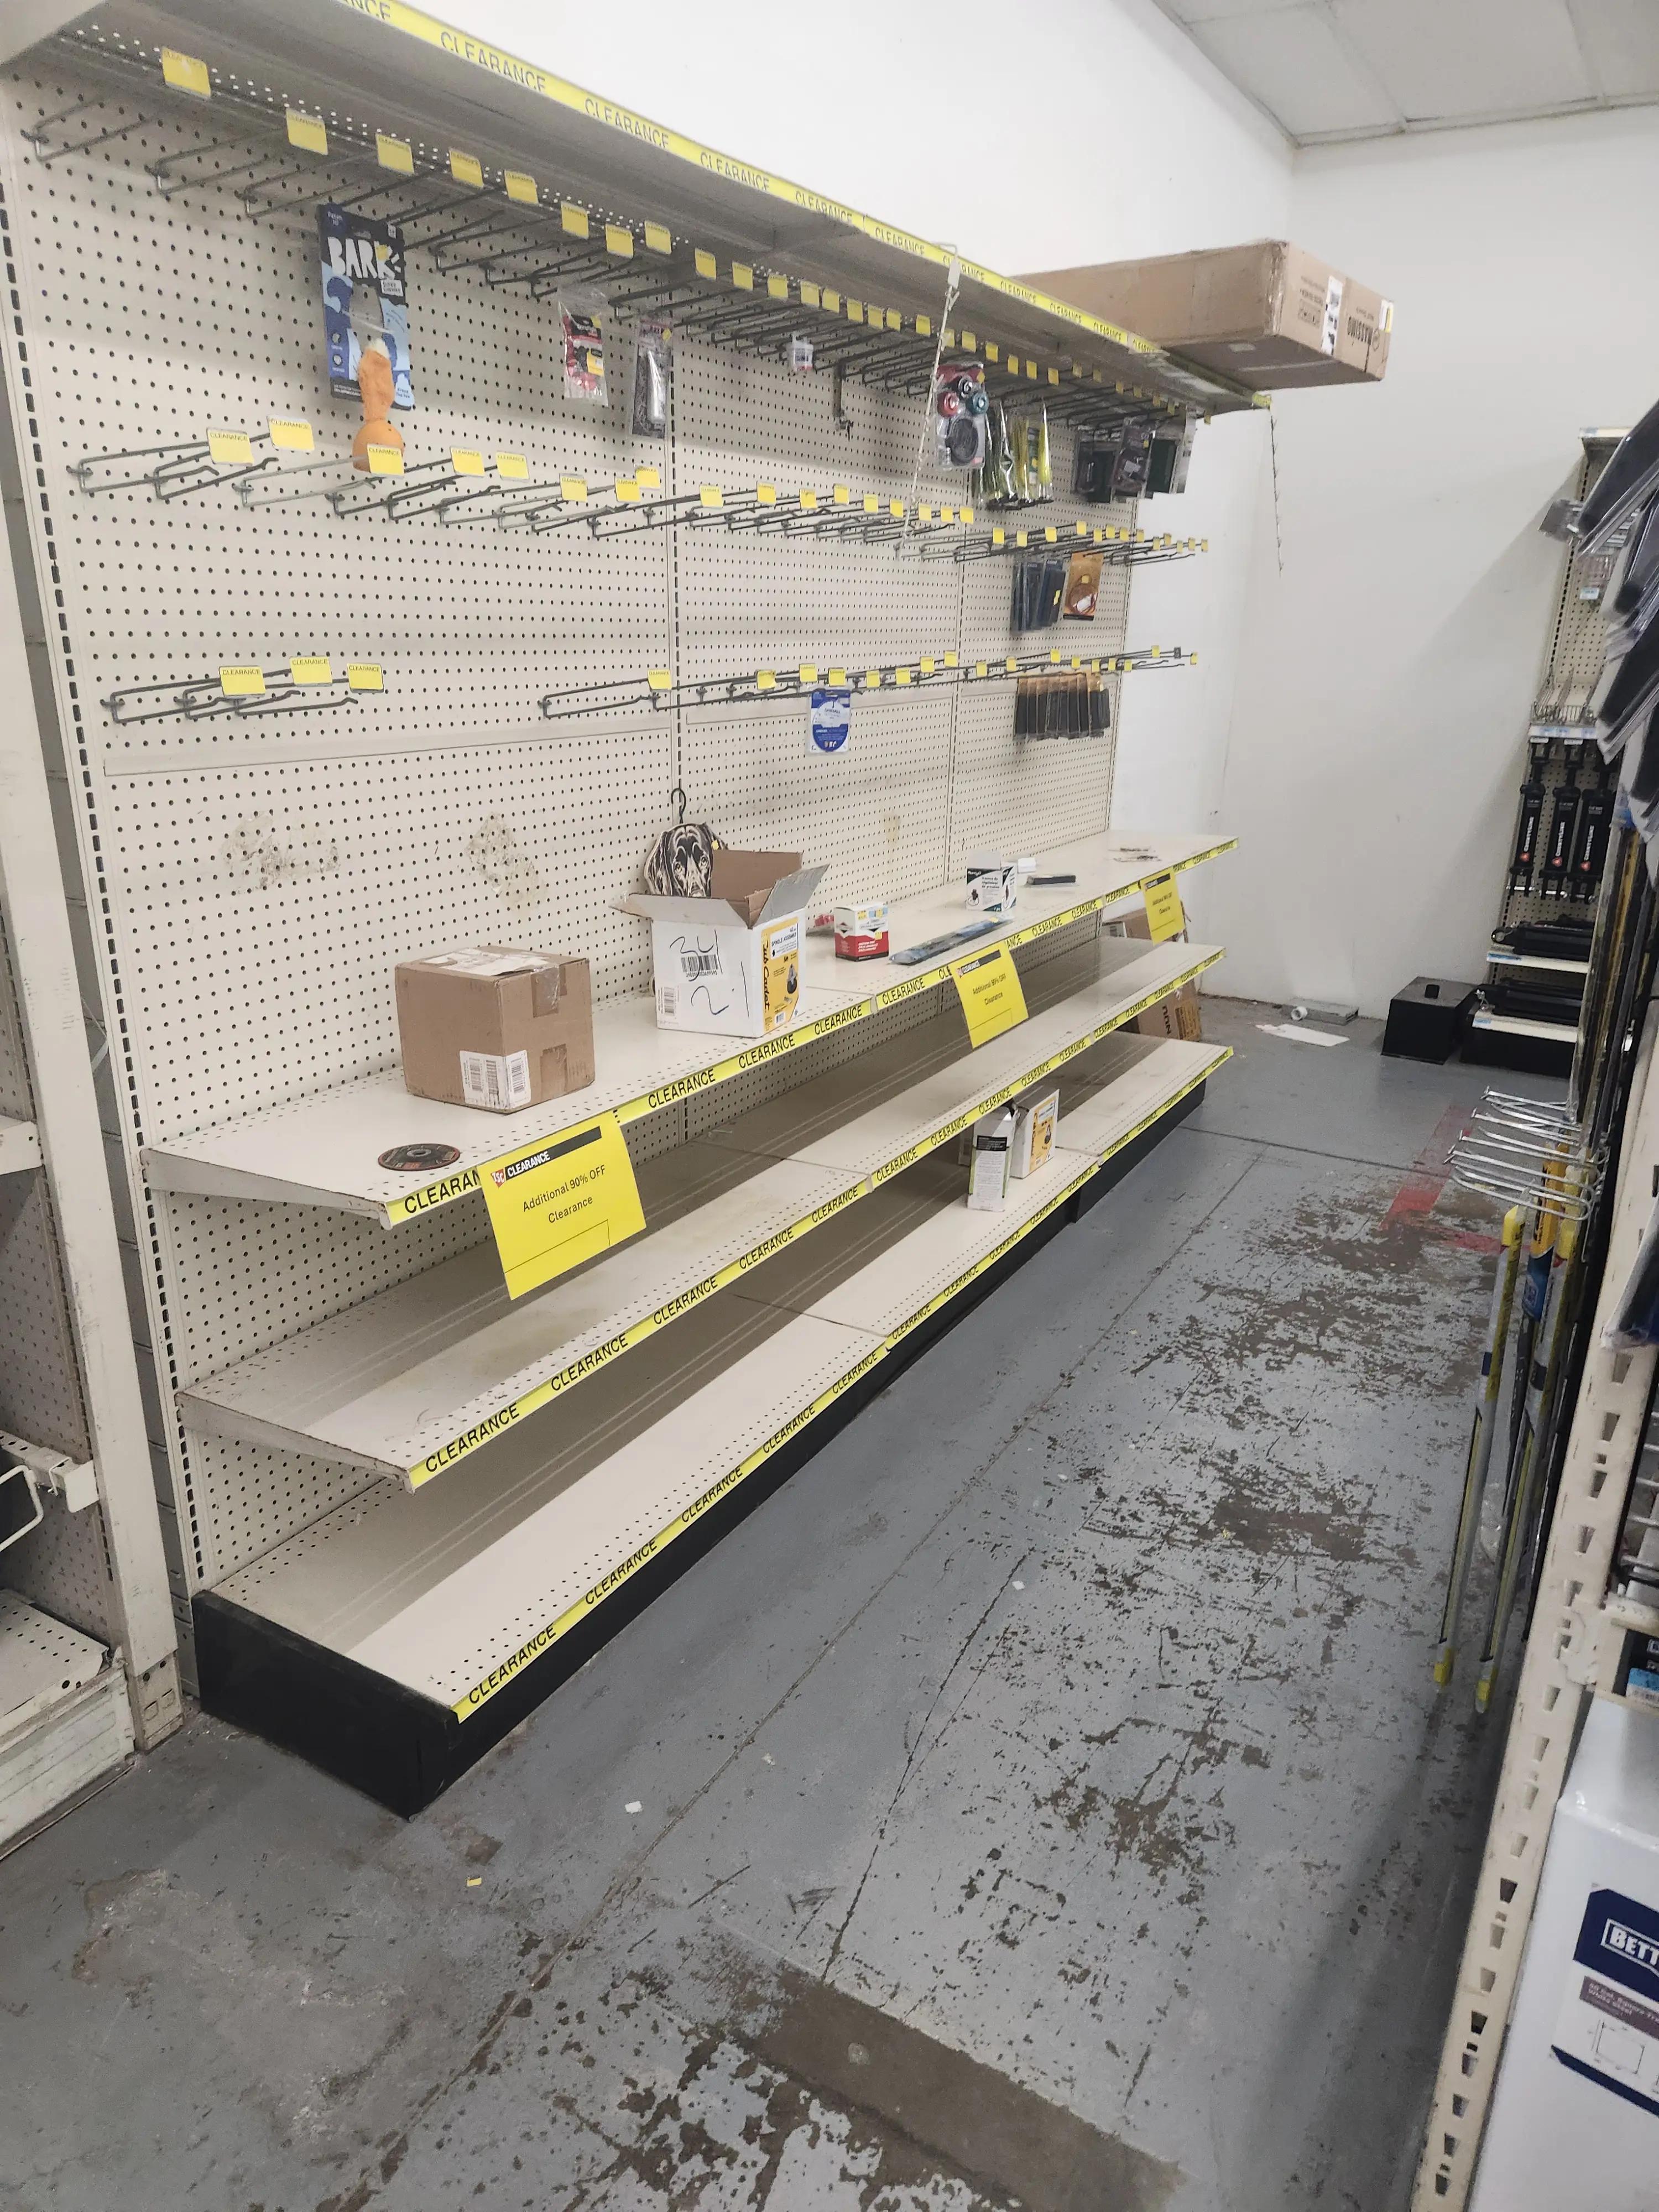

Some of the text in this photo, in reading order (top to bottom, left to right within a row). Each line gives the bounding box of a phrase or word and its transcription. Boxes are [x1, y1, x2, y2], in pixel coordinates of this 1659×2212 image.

[441, 31, 546, 92] CLEARANCE
[585, 97, 669, 148] CLEARANCE
[700, 152, 770, 191] CLEARANCE
[795, 190, 852, 222] CLEARANCE
[875, 227, 925, 255] CLEARANCE
[943, 255, 985, 282] CLRANCE
[328, 236, 395, 280] BARK
[210, 431, 249, 442] CLEARANCE
[270, 418, 309, 430] CLEARANCE
[369, 446, 400, 456] CLEARANCE
[292, 658, 328, 666] CLEARANCE
[404, 1168, 480, 1214] CLEARAN
[648, 1068, 716, 1108] CLEARANCE
[739, 1034, 795, 1068] CLEARANCE
[814, 1005, 862, 1035] CLEARANCE
[882, 978, 925, 1005] CLEARANCE
[1032, 915, 1062, 937] CLEARANCE
[1072, 900, 1098, 920] CLEARANCE
[1106, 886, 1131, 903] CLEARANCE
[492, 1151, 550, 1183] TSC CLEARANCE
[524, 1165, 606, 1212] Additional 90% OFF
[549, 1197, 593, 1224] Clearance
[426, 1402, 519, 1473] CLEARANCE
[551, 1332, 628, 1391] CLEARANCE
[654, 1275, 718, 1324] CLEARANCE
[739, 1226, 794, 1269] CLEARANCE
[812, 1186, 858, 1223] CLEARANCE
[877, 1148, 918, 1181] CLEARANCE
[931, 1117, 967, 1146] CLEARANCE
[978, 1087, 1011, 1115] CLEARANCE
[1021, 1062, 1051, 1087] CLEARANCE
[1060, 1039, 1086, 1061] CLEARANCE
[1094, 1018, 1118, 1039] CLEARANCE
[1125, 997, 1147, 1018] CLEARANCE
[469, 1624, 556, 1704] CLEARANCE
[585, 1538, 658, 1605] CLEARANCE
[681, 1465, 743, 1523] CLEARANCE
[763, 1402, 816, 1453] CLEARANCE
[832, 1350, 878, 1394] CLEARANCE
[892, 1303, 931, 1339] CLEARANCE
[944, 1265, 979, 1297] CLEARANCE
[989, 1230, 1021, 1260] CLEARANCE
[1030, 1198, 1058, 1225] CLEARANCE
[1610, 1926, 1659, 1966] BETT
